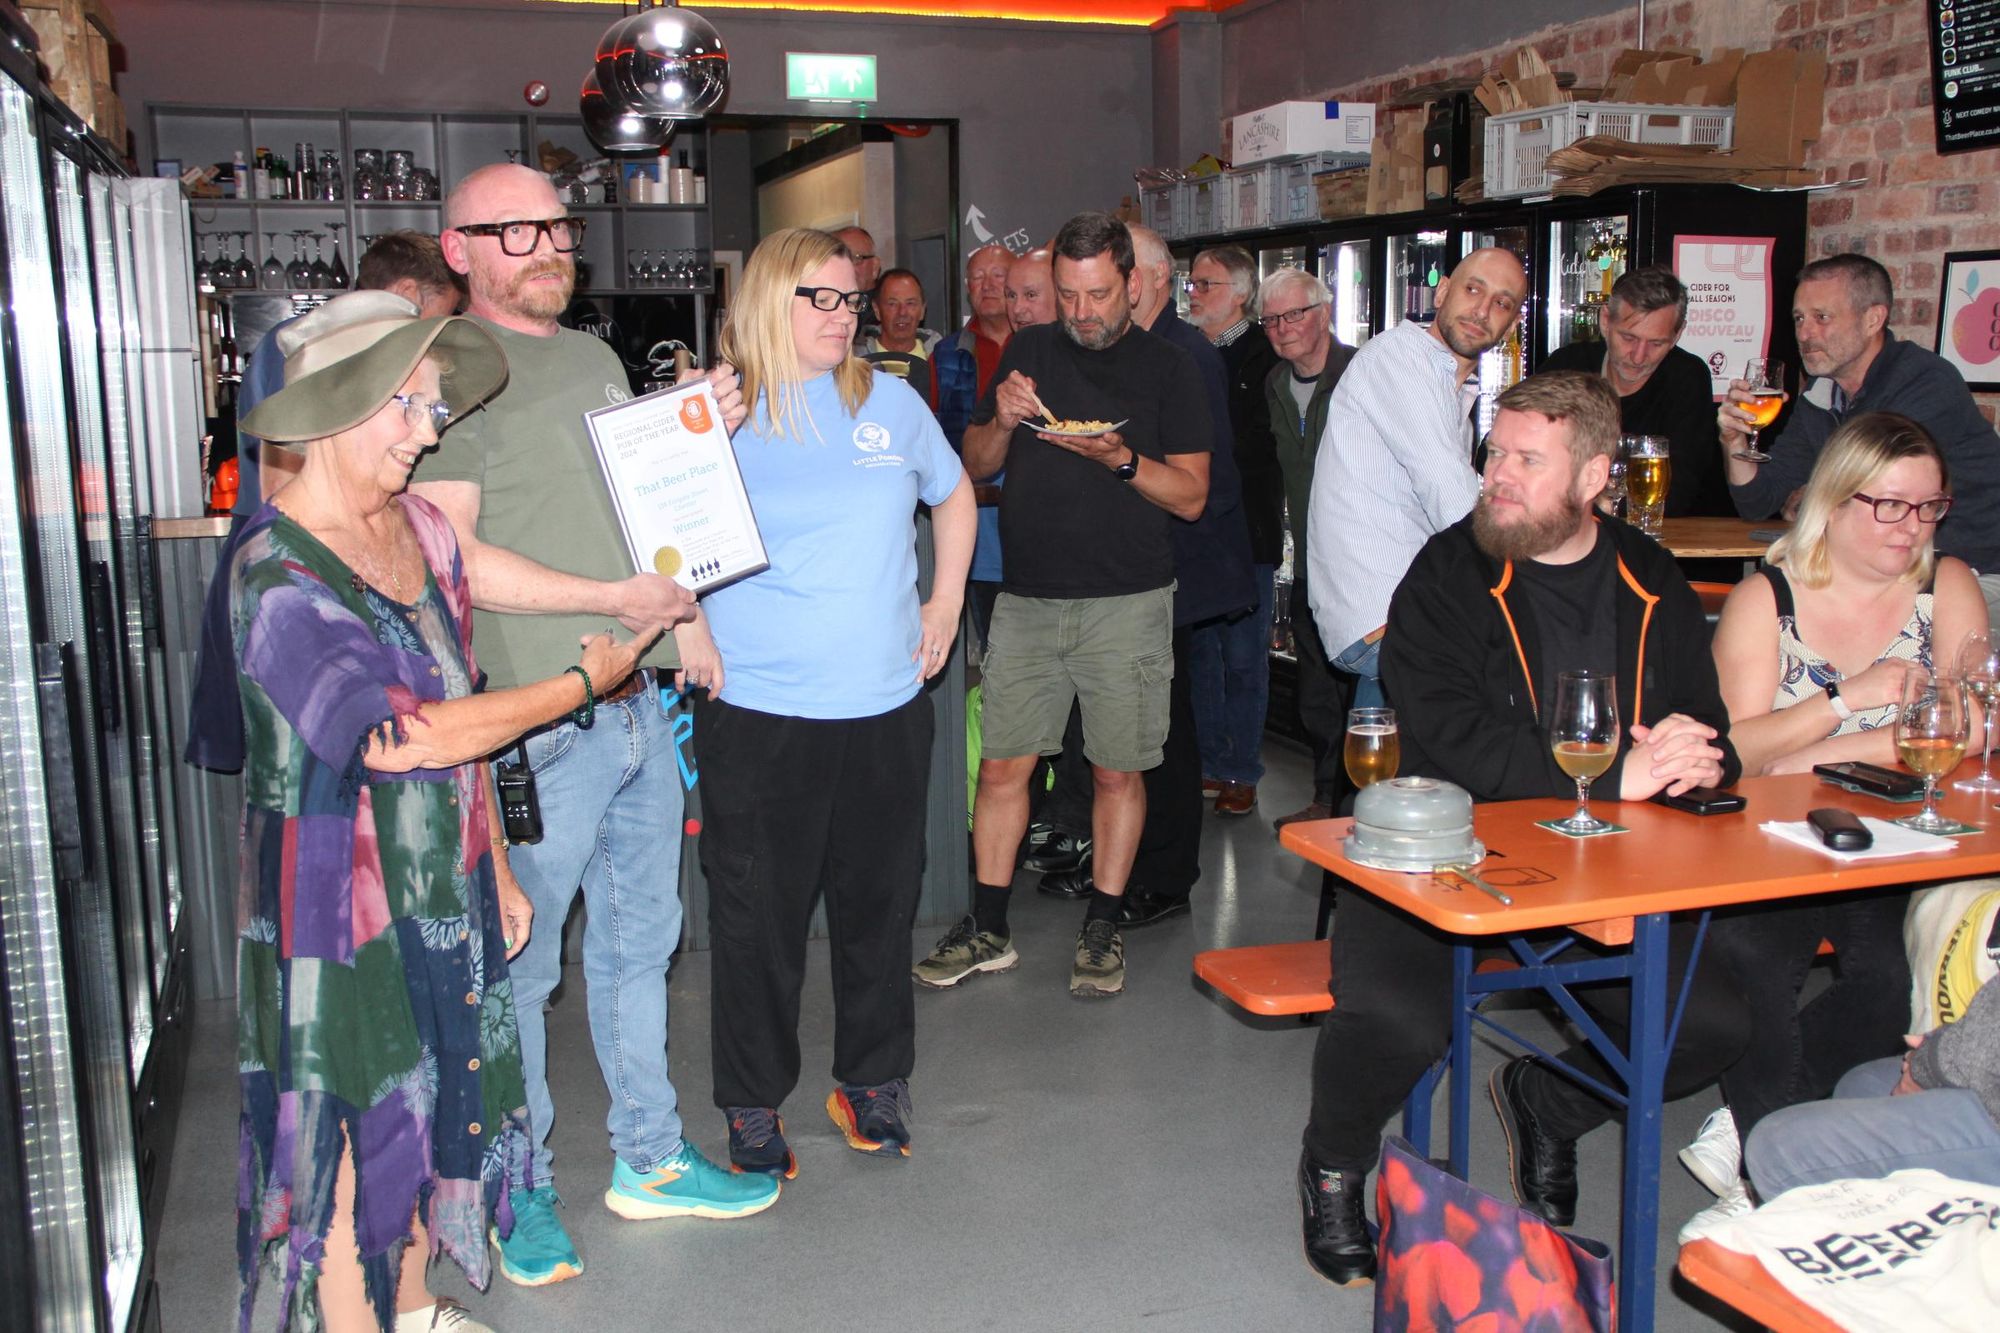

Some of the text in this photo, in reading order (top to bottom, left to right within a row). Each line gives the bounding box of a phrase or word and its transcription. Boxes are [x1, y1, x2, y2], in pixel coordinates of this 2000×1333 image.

[1944, 67, 1962, 78] FUNK
[1239, 122, 1280, 151] LANCASHIRE
[1690, 283, 1730, 291] CIDER FOR
[1689, 294, 1736, 303] ALL SEASONS
[1689, 309, 1735, 322] DISCO
[1687, 324, 1755, 337] NOUVEAU
[614, 421, 652, 441] REGIONAL
[652, 415, 676, 433] CIDER
[617, 424, 680, 451] PUB OF THE YEAR
[620, 448, 639, 461] 2024
[634, 460, 719, 497] That Beer Place
[672, 515, 711, 536] Winner
